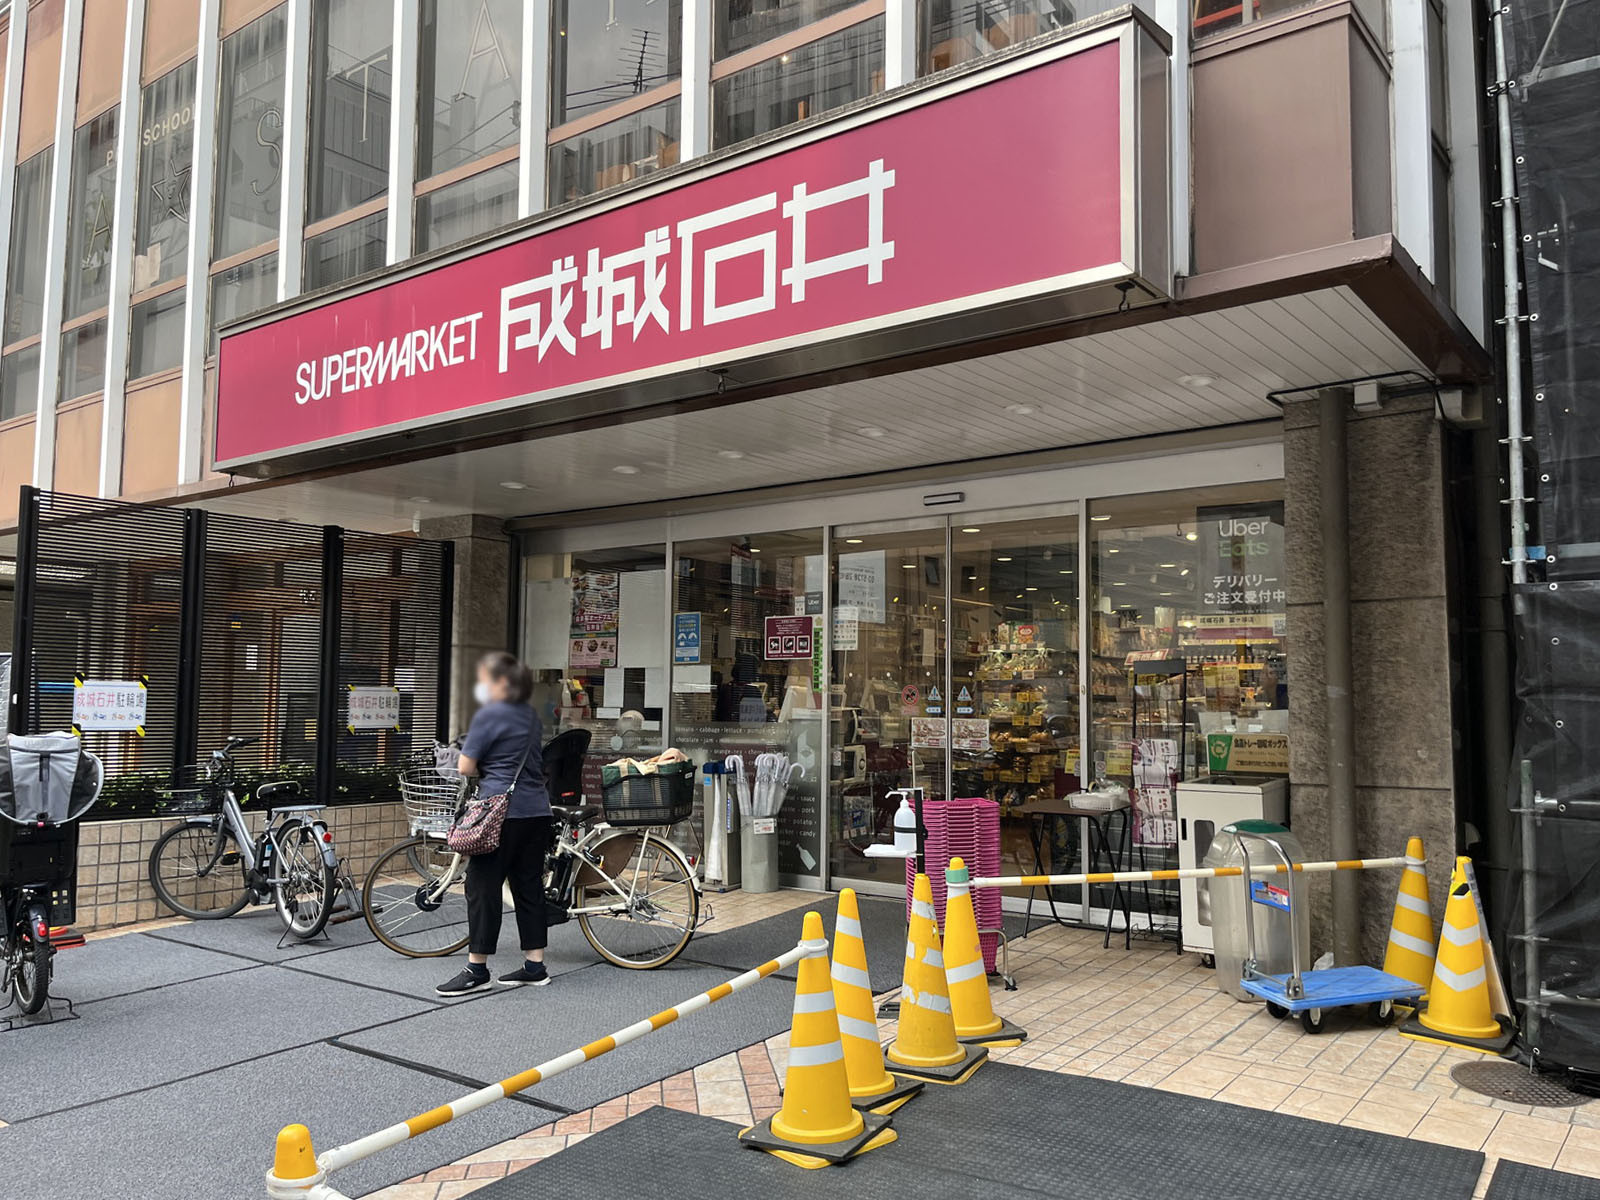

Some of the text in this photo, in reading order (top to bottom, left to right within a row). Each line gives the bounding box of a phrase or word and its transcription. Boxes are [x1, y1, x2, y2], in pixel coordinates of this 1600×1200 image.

[143, 105, 196, 147] SCHOO
[294, 159, 895, 405] SUPERMARKET 成城石井
[1219, 520, 1268, 537] Uber
[1219, 540, 1269, 557] Eats
[1213, 574, 1278, 588] デリバリー
[1203, 589, 1286, 605] ご注文受付中
[77, 691, 145, 708] 成城石井駐輪場
[699, 726, 721, 734] cabbage
[801, 806, 815, 814] pork
[799, 830, 816, 838] candy
